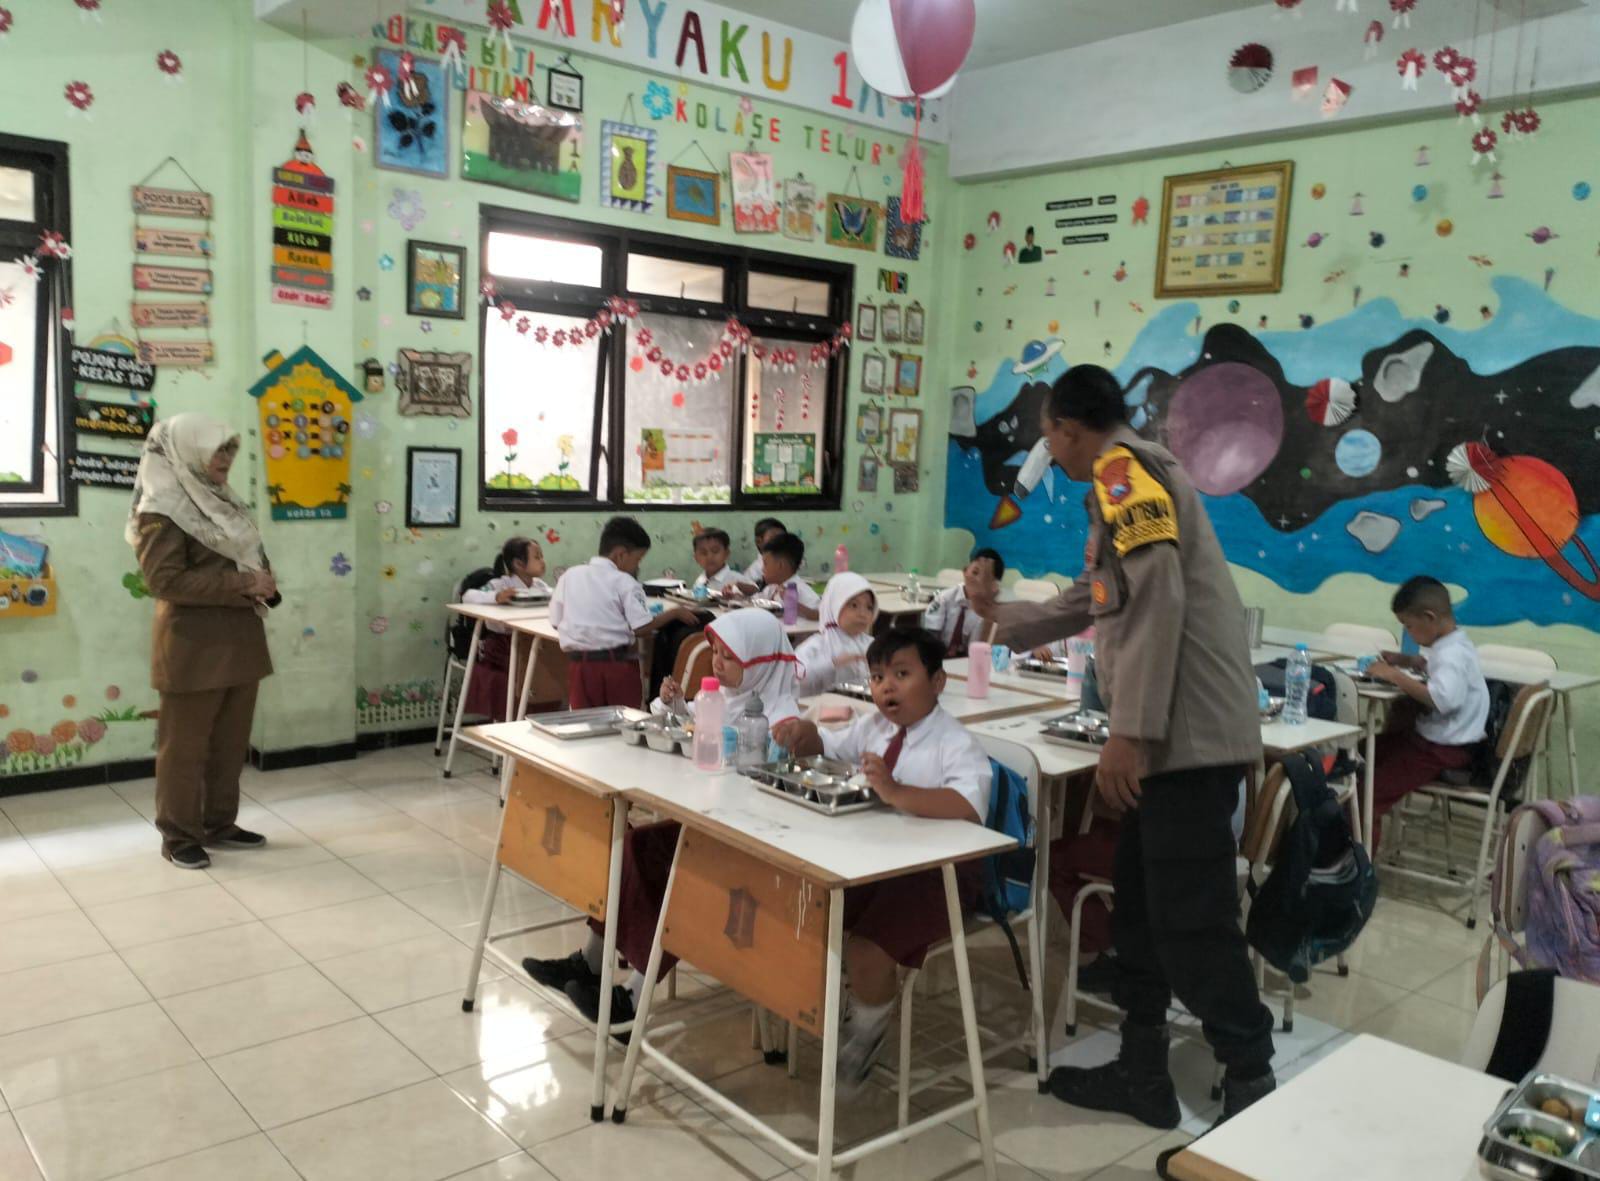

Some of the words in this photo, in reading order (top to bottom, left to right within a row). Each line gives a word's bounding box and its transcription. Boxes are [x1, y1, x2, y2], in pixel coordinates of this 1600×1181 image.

[676, 97, 780, 143] KOLASE
[803, 125, 882, 165] TELUR
[78, 363, 125, 385] KELAS
